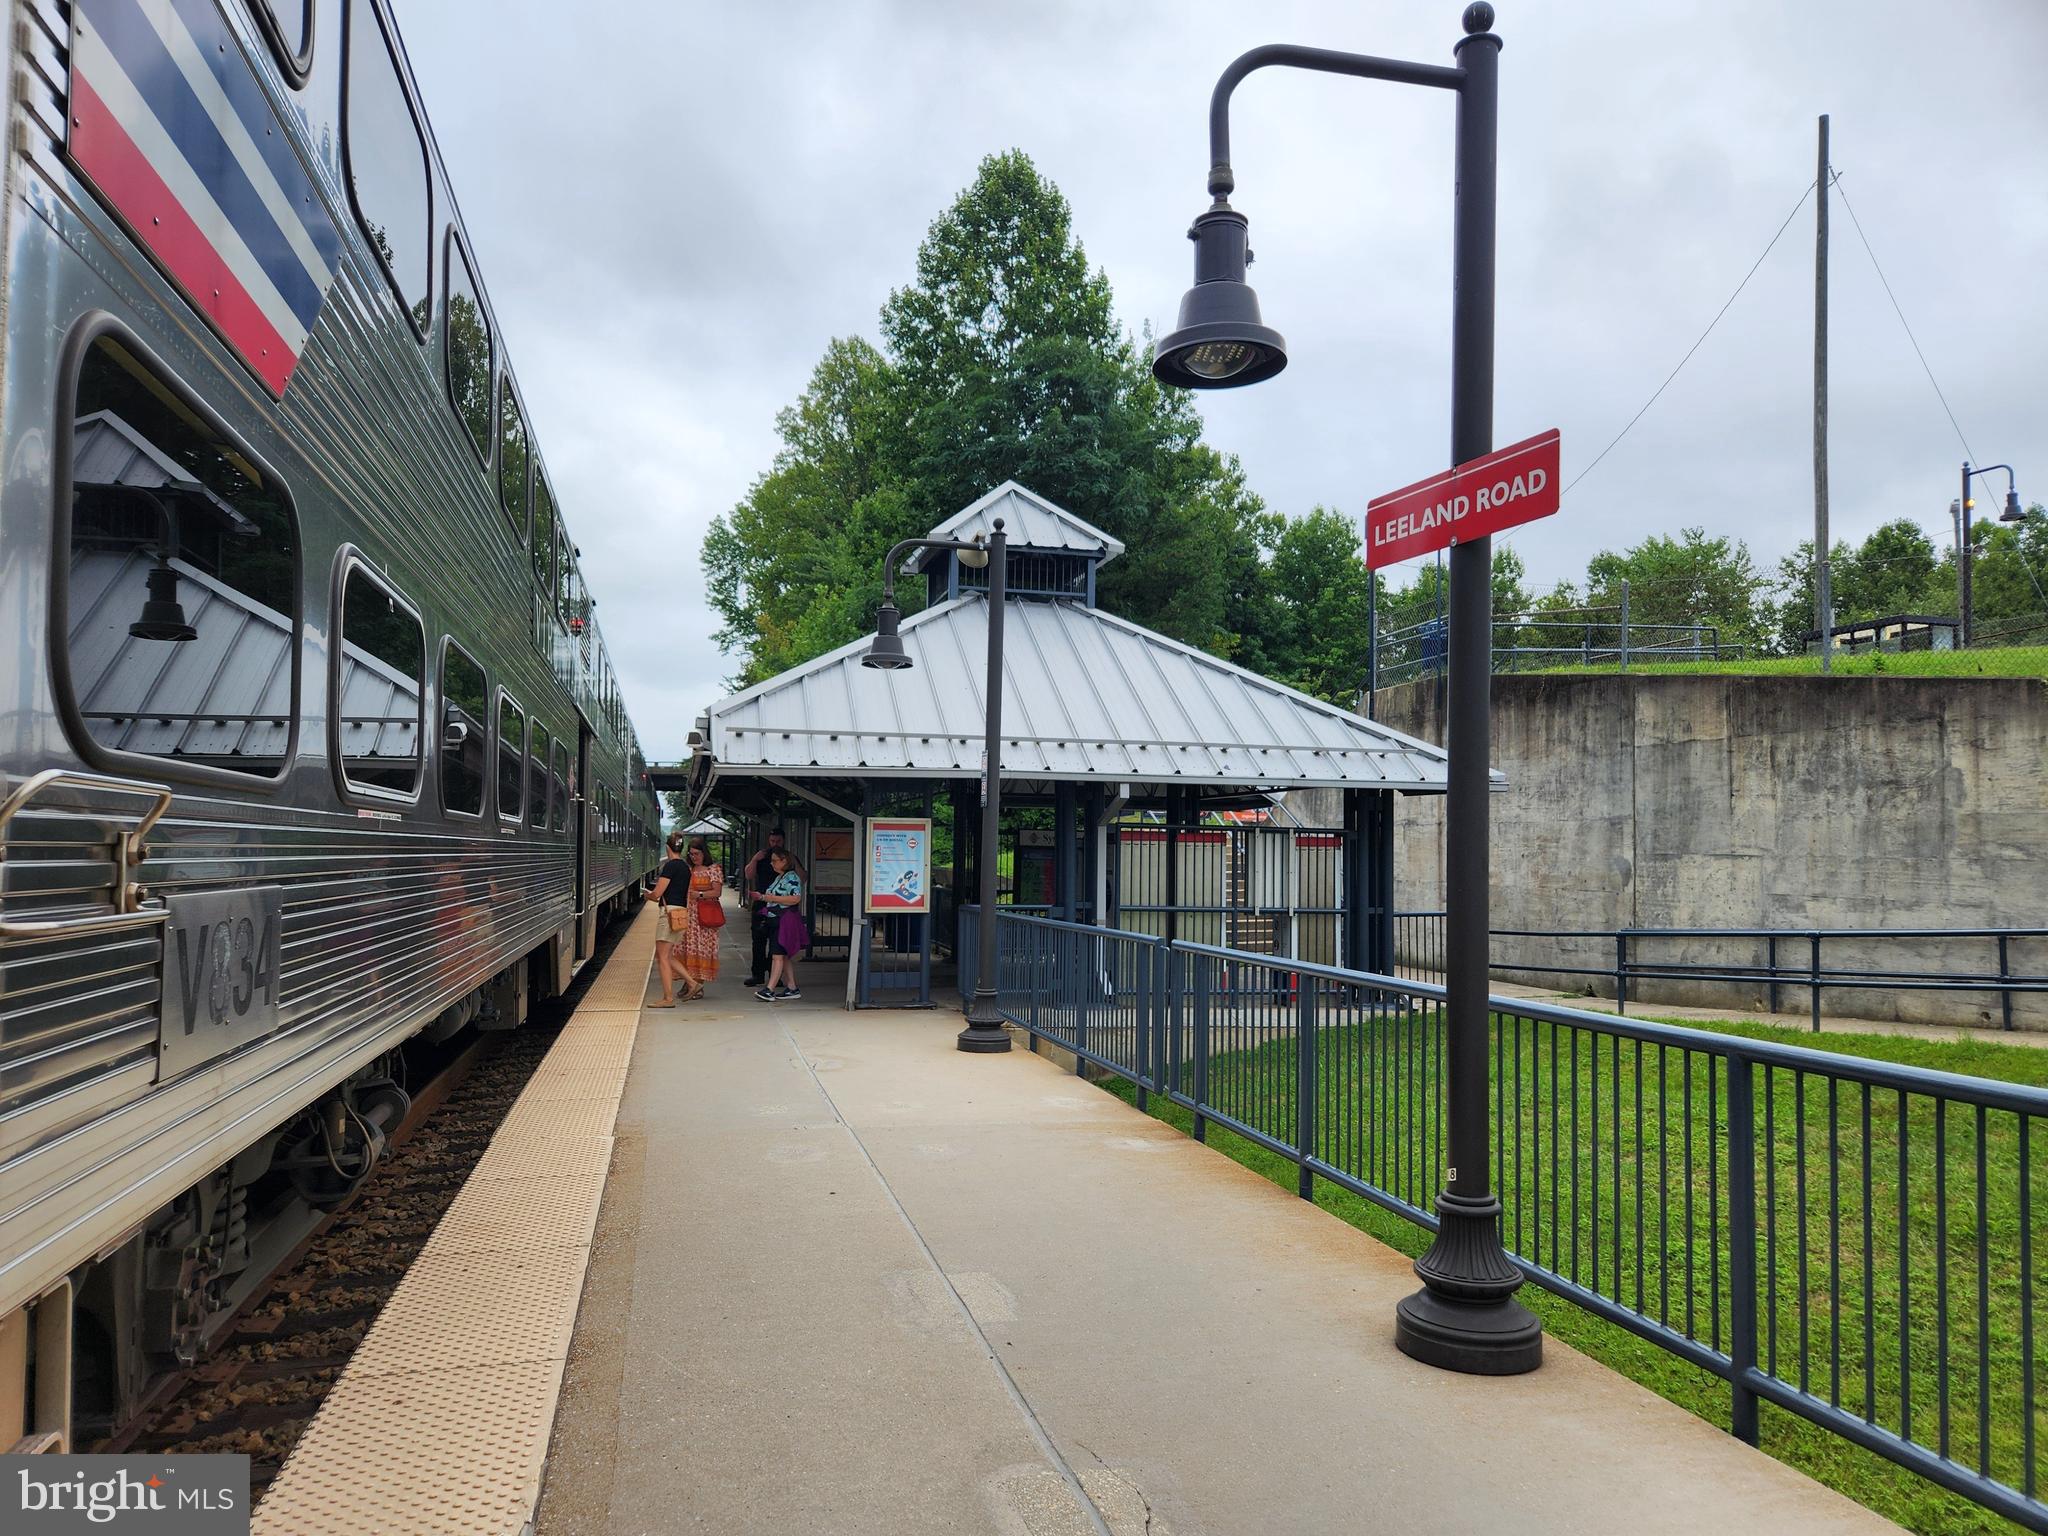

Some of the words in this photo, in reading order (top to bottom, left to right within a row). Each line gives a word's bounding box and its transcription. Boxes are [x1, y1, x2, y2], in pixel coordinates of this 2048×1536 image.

[1374, 495, 1470, 547] LEELAND
[1476, 468, 1547, 513] ROAD
[176, 914, 274, 1036] V834
